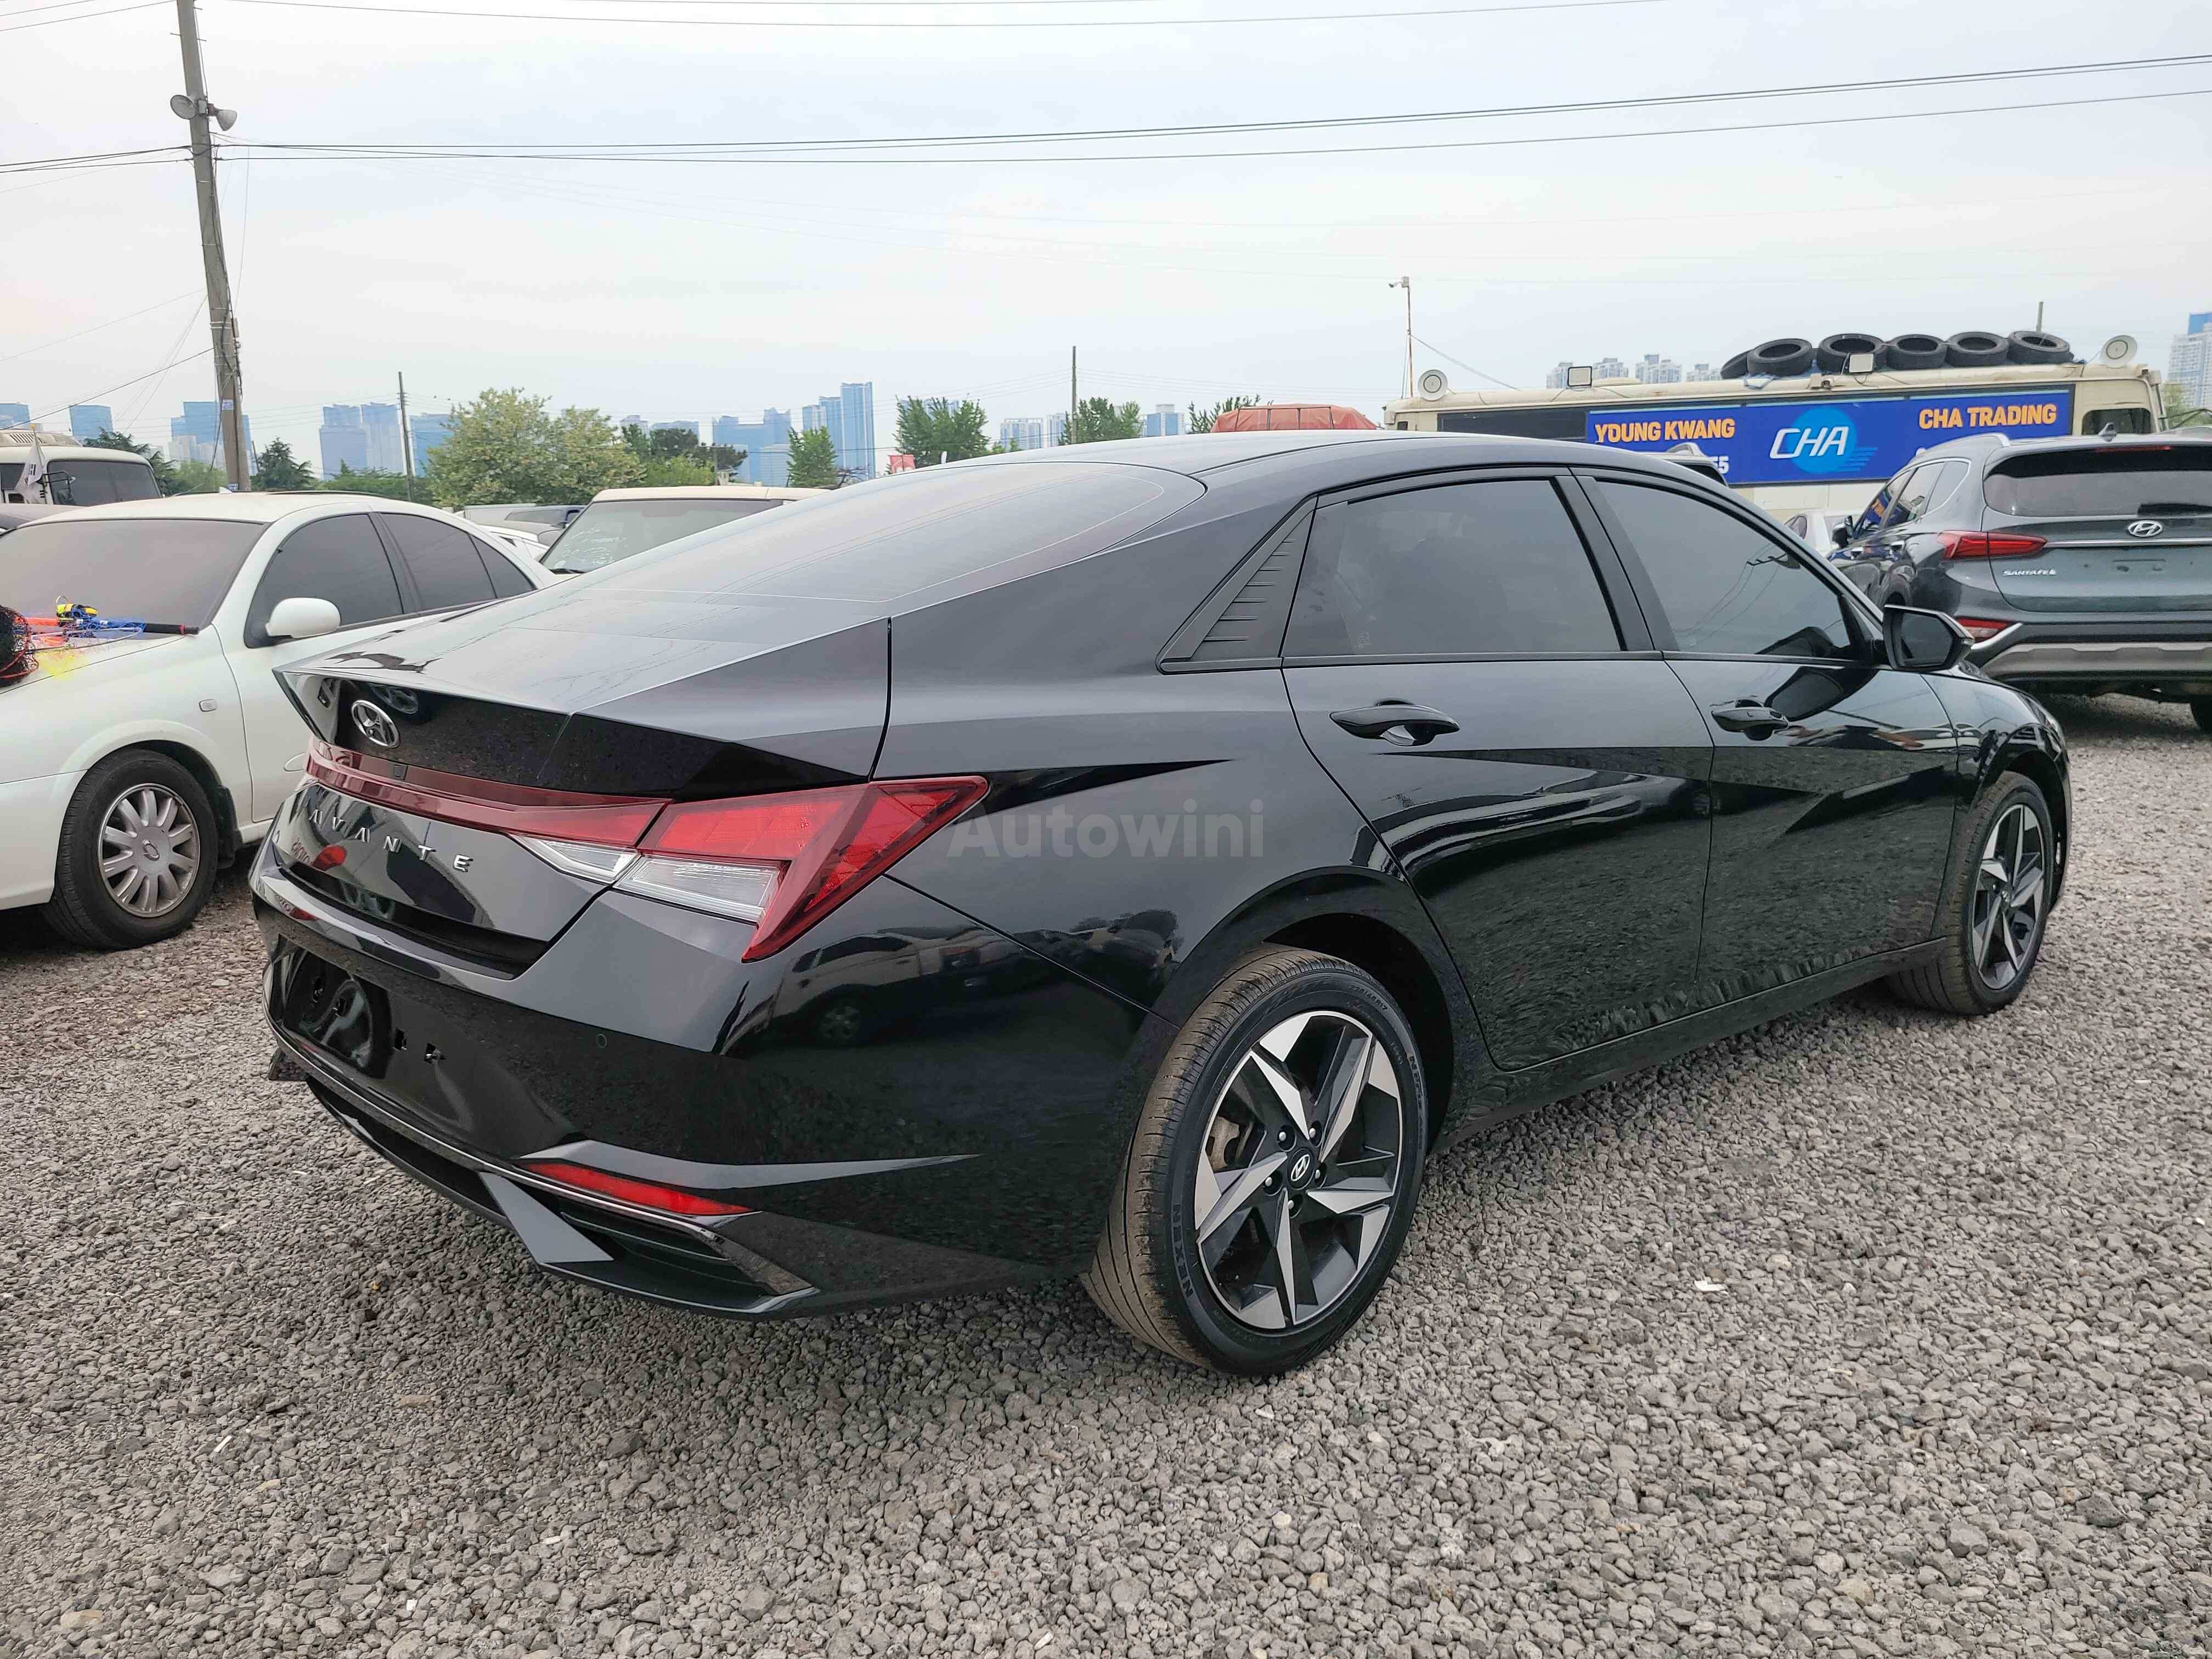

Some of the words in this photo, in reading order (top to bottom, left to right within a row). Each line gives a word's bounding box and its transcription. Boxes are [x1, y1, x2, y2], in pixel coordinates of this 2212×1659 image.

[1595, 422, 1661, 443] YOUNG
[1664, 418, 1735, 441] KWANG
[1919, 407, 1963, 430] CHA
[1967, 403, 2057, 428] TRADING
[1769, 426, 1850, 460] CHA
[309, 809, 473, 873] AVANTE
[1172, 1203, 1194, 1297] NEXEN
